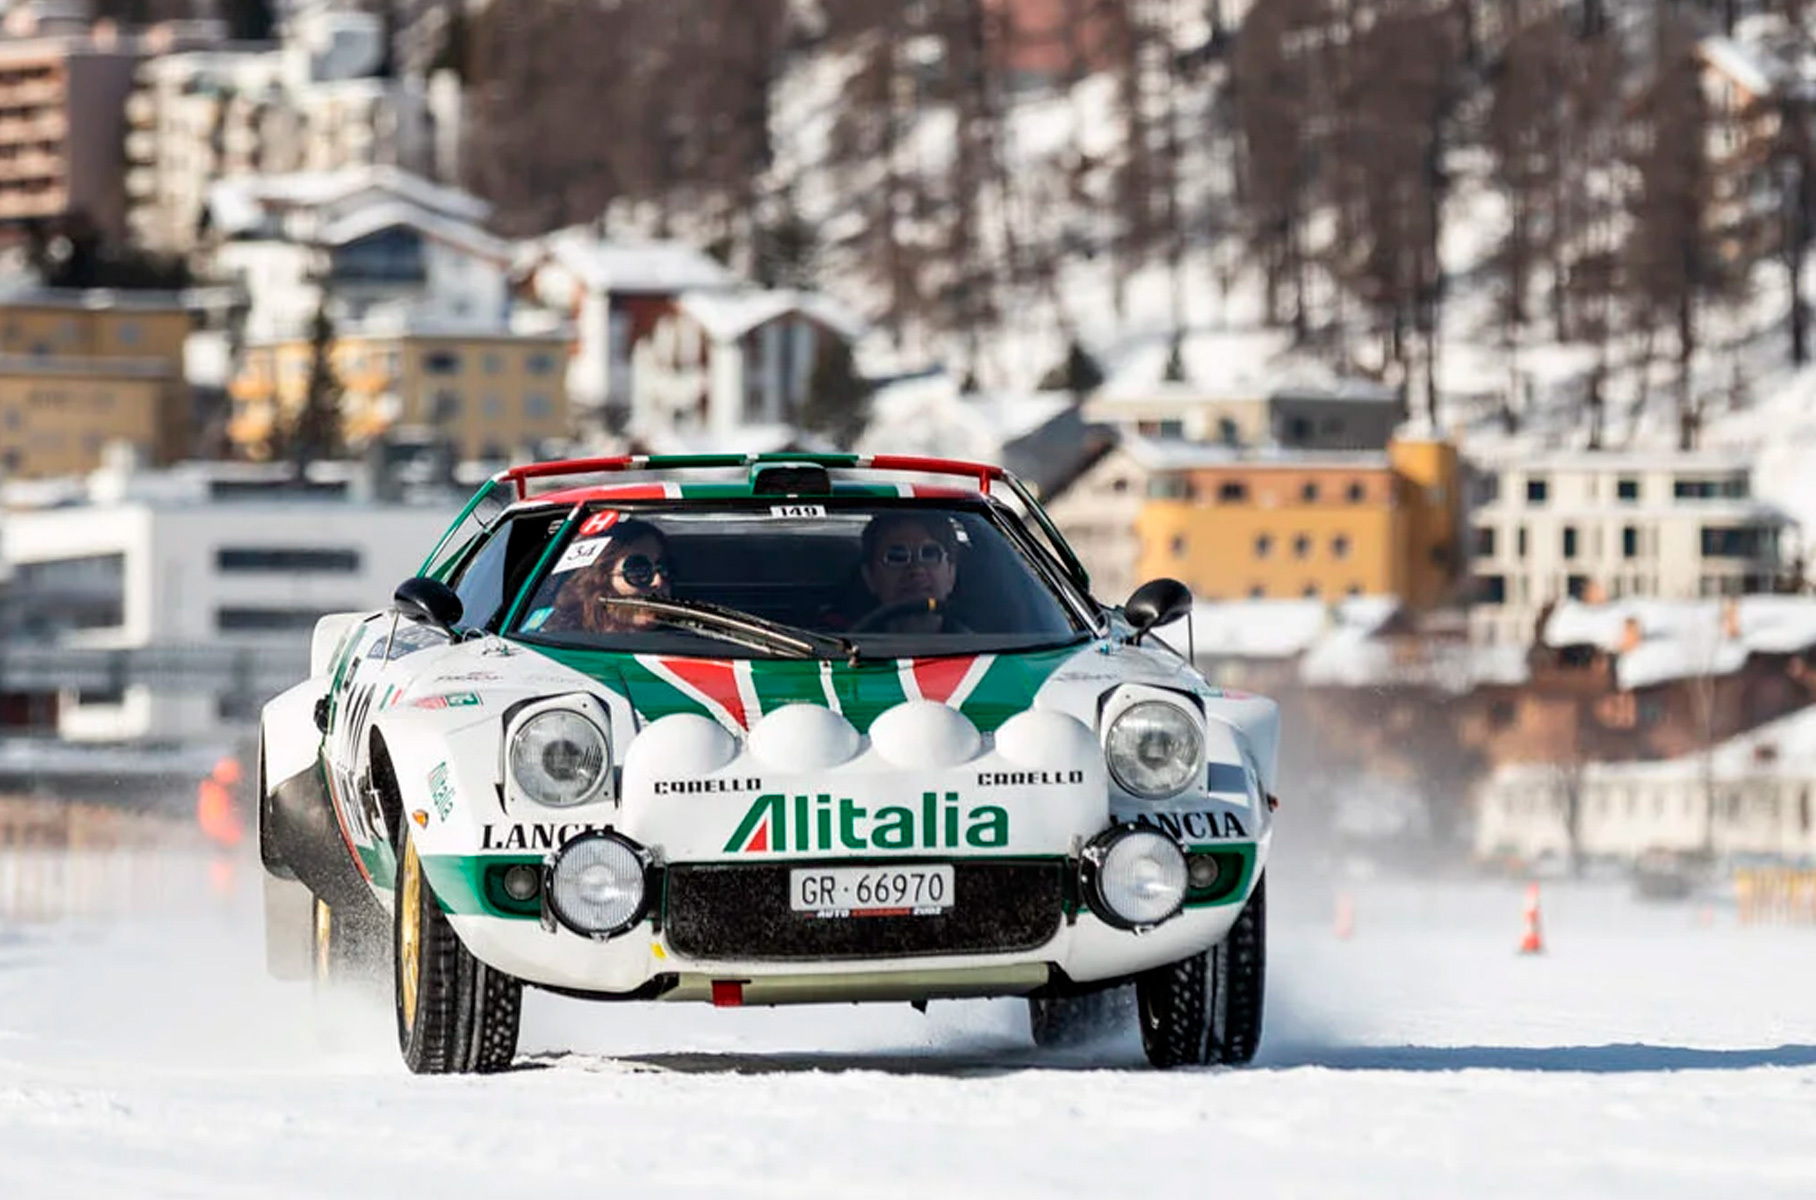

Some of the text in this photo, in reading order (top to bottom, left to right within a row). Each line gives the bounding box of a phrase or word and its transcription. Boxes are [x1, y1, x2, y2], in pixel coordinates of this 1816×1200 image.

[654, 778, 762, 794] CARELLO
[977, 770, 1083, 787] CARELLO
[722, 792, 1009, 852] Alitalia
